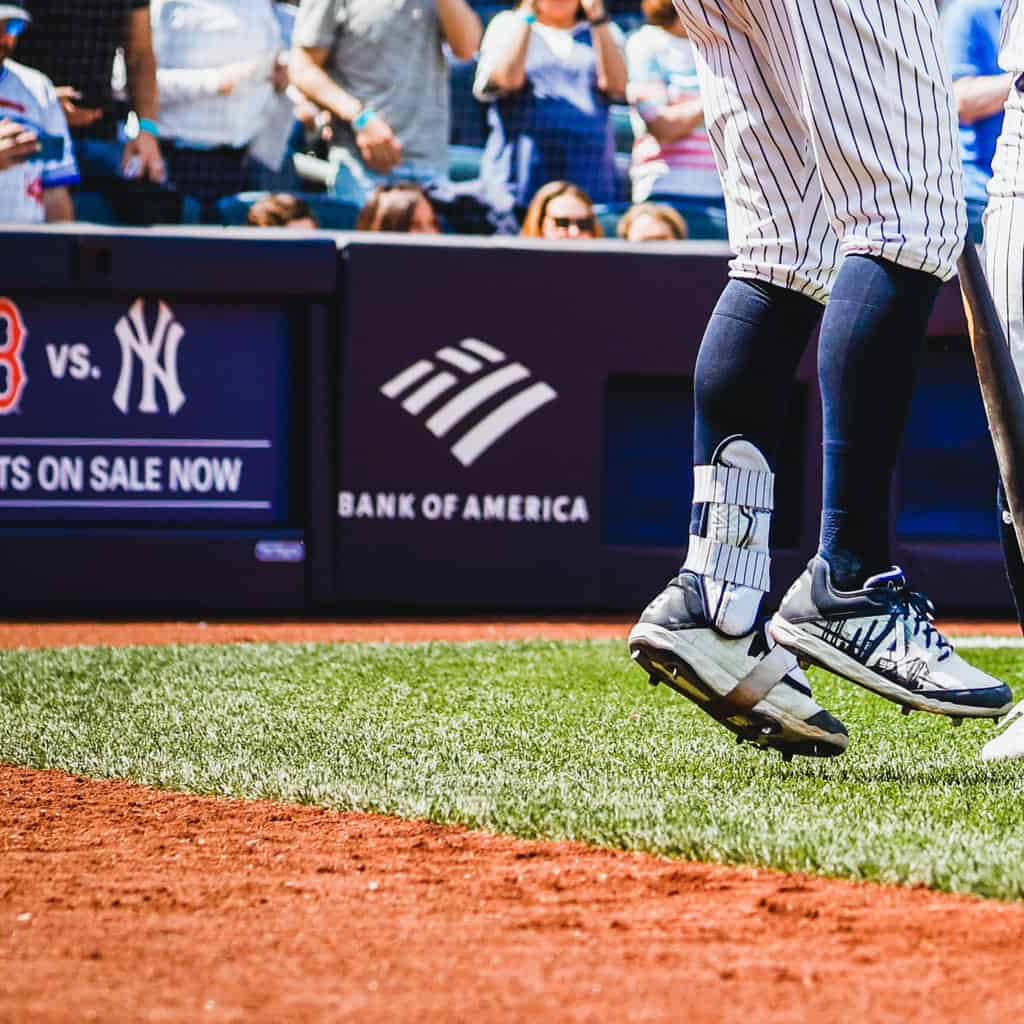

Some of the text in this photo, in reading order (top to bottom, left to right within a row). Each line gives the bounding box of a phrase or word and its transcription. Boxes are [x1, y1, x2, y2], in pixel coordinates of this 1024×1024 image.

[113, 297, 187, 415] NY
[38, 456, 83, 491] ON
[89, 457, 162, 492] SALE
[169, 457, 243, 492] NOW
[338, 491, 589, 522] BANK OF AMERICA
